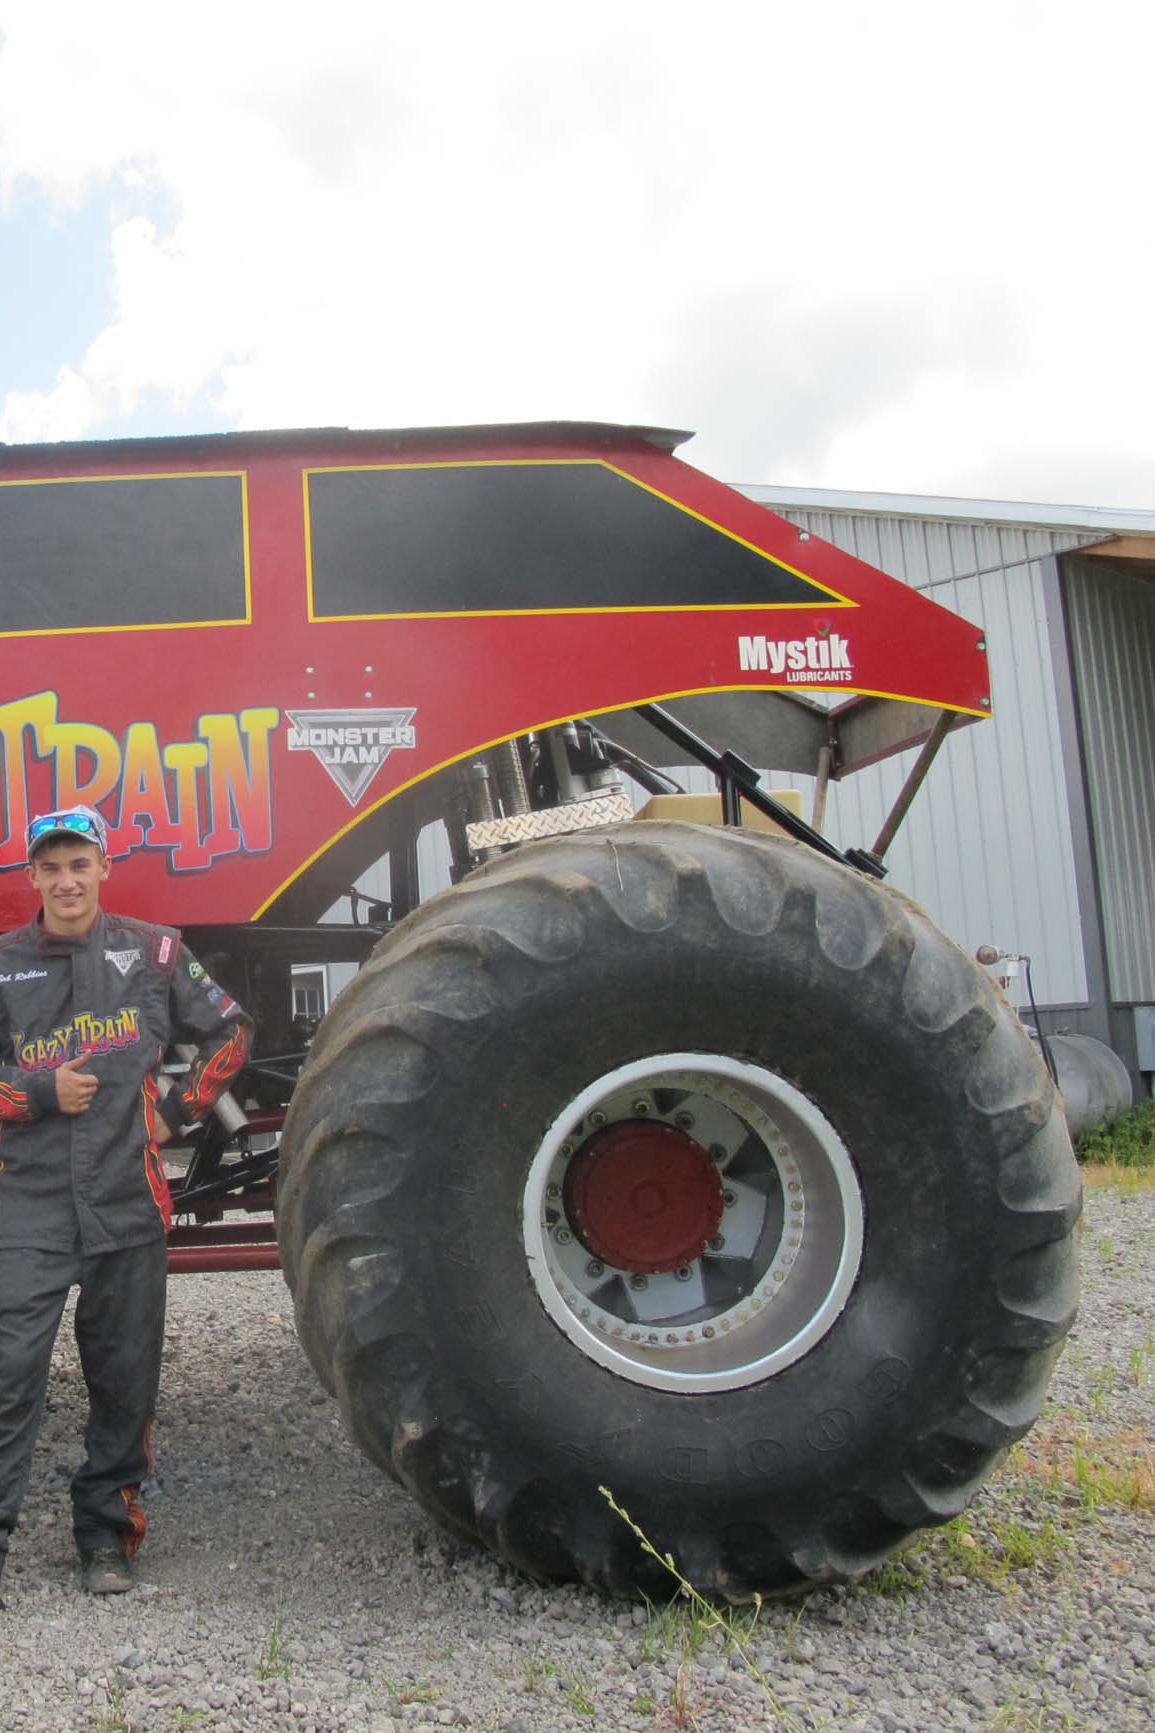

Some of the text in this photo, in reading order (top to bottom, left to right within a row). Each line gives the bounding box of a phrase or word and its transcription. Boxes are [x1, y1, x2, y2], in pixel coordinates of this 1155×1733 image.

[738, 633, 854, 674] Mystik
[786, 670, 853, 682] LUBRICANTS
[288, 725, 414, 746] MONSTER
[324, 746, 380, 764] JAM
[74, 1009, 139, 1054] TRAIN
